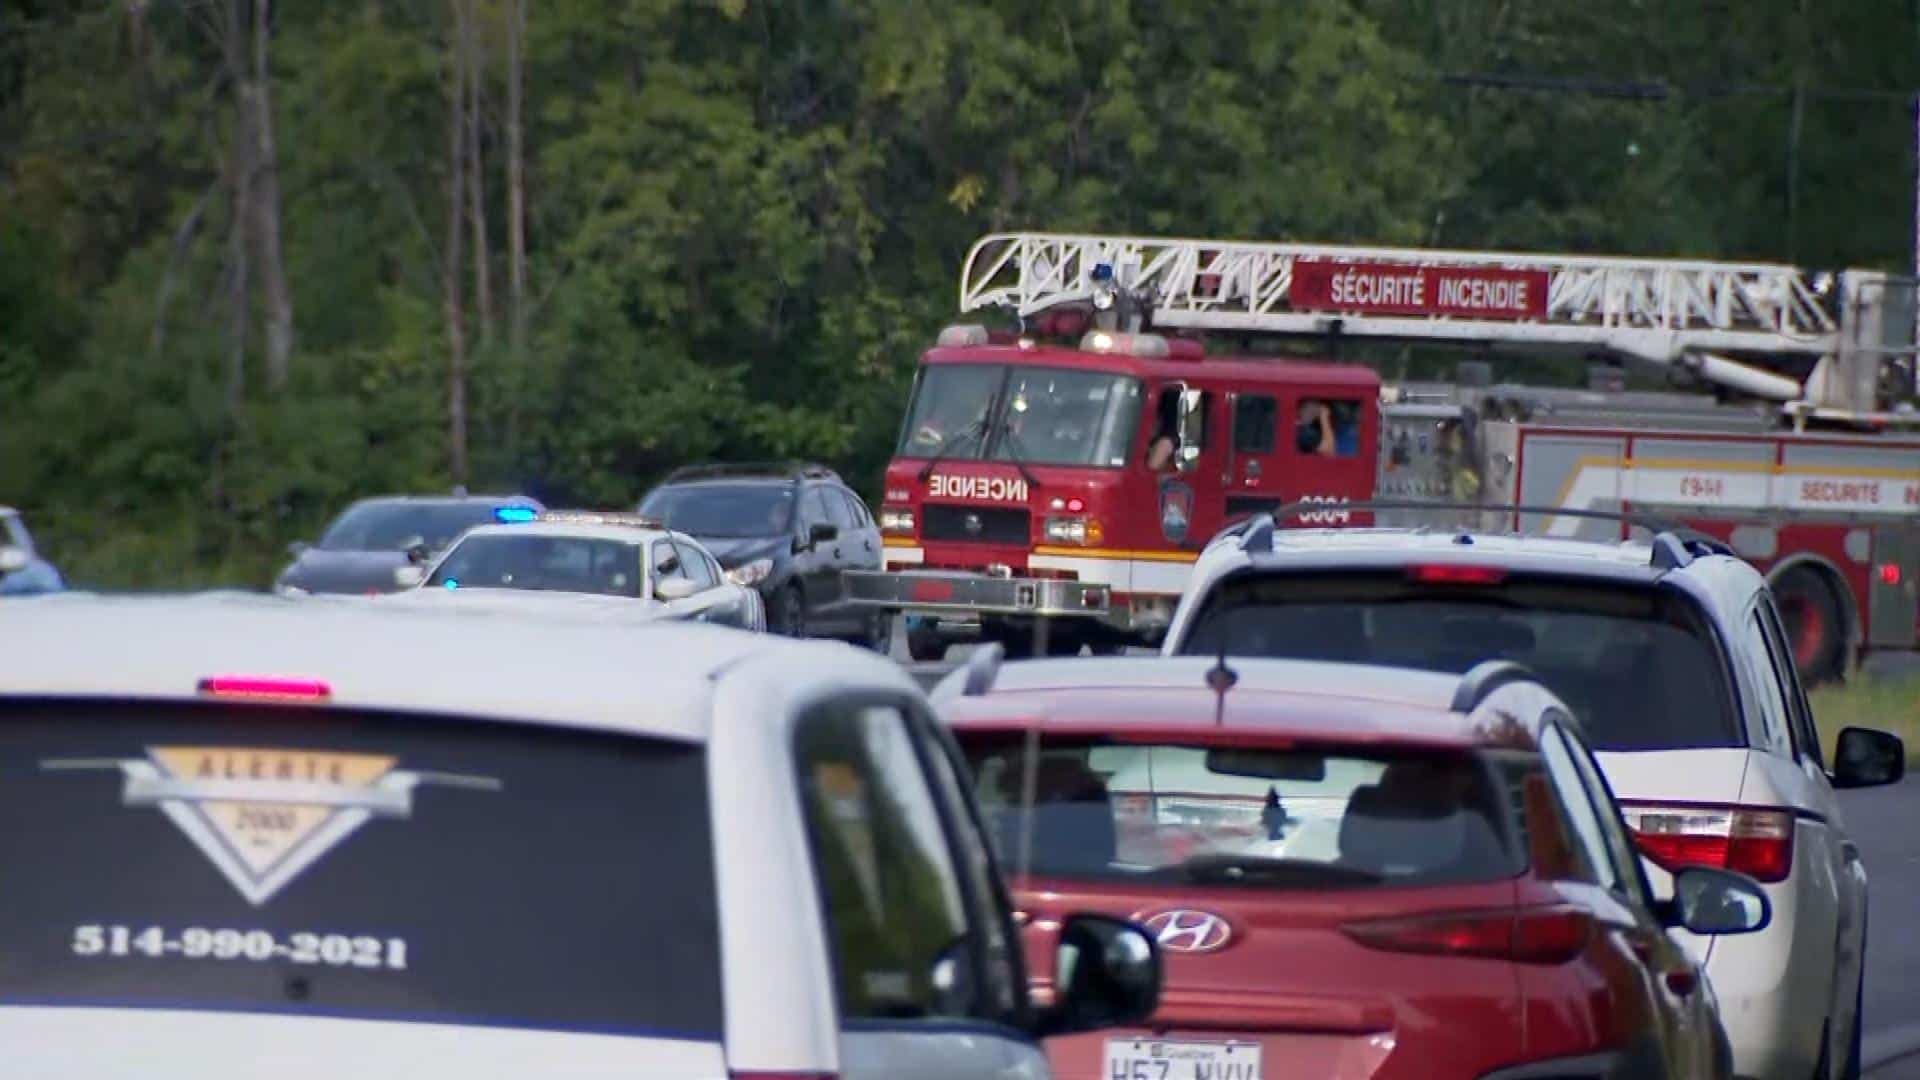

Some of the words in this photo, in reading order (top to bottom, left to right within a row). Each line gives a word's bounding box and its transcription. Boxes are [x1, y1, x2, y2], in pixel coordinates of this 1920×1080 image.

[1331, 268, 1425, 305] SÉCURITÉ
[1438, 276, 1529, 310] INCENDIE
[197, 755, 342, 784] ALERTE
[72, 925, 407, 970] 514-990-2021
